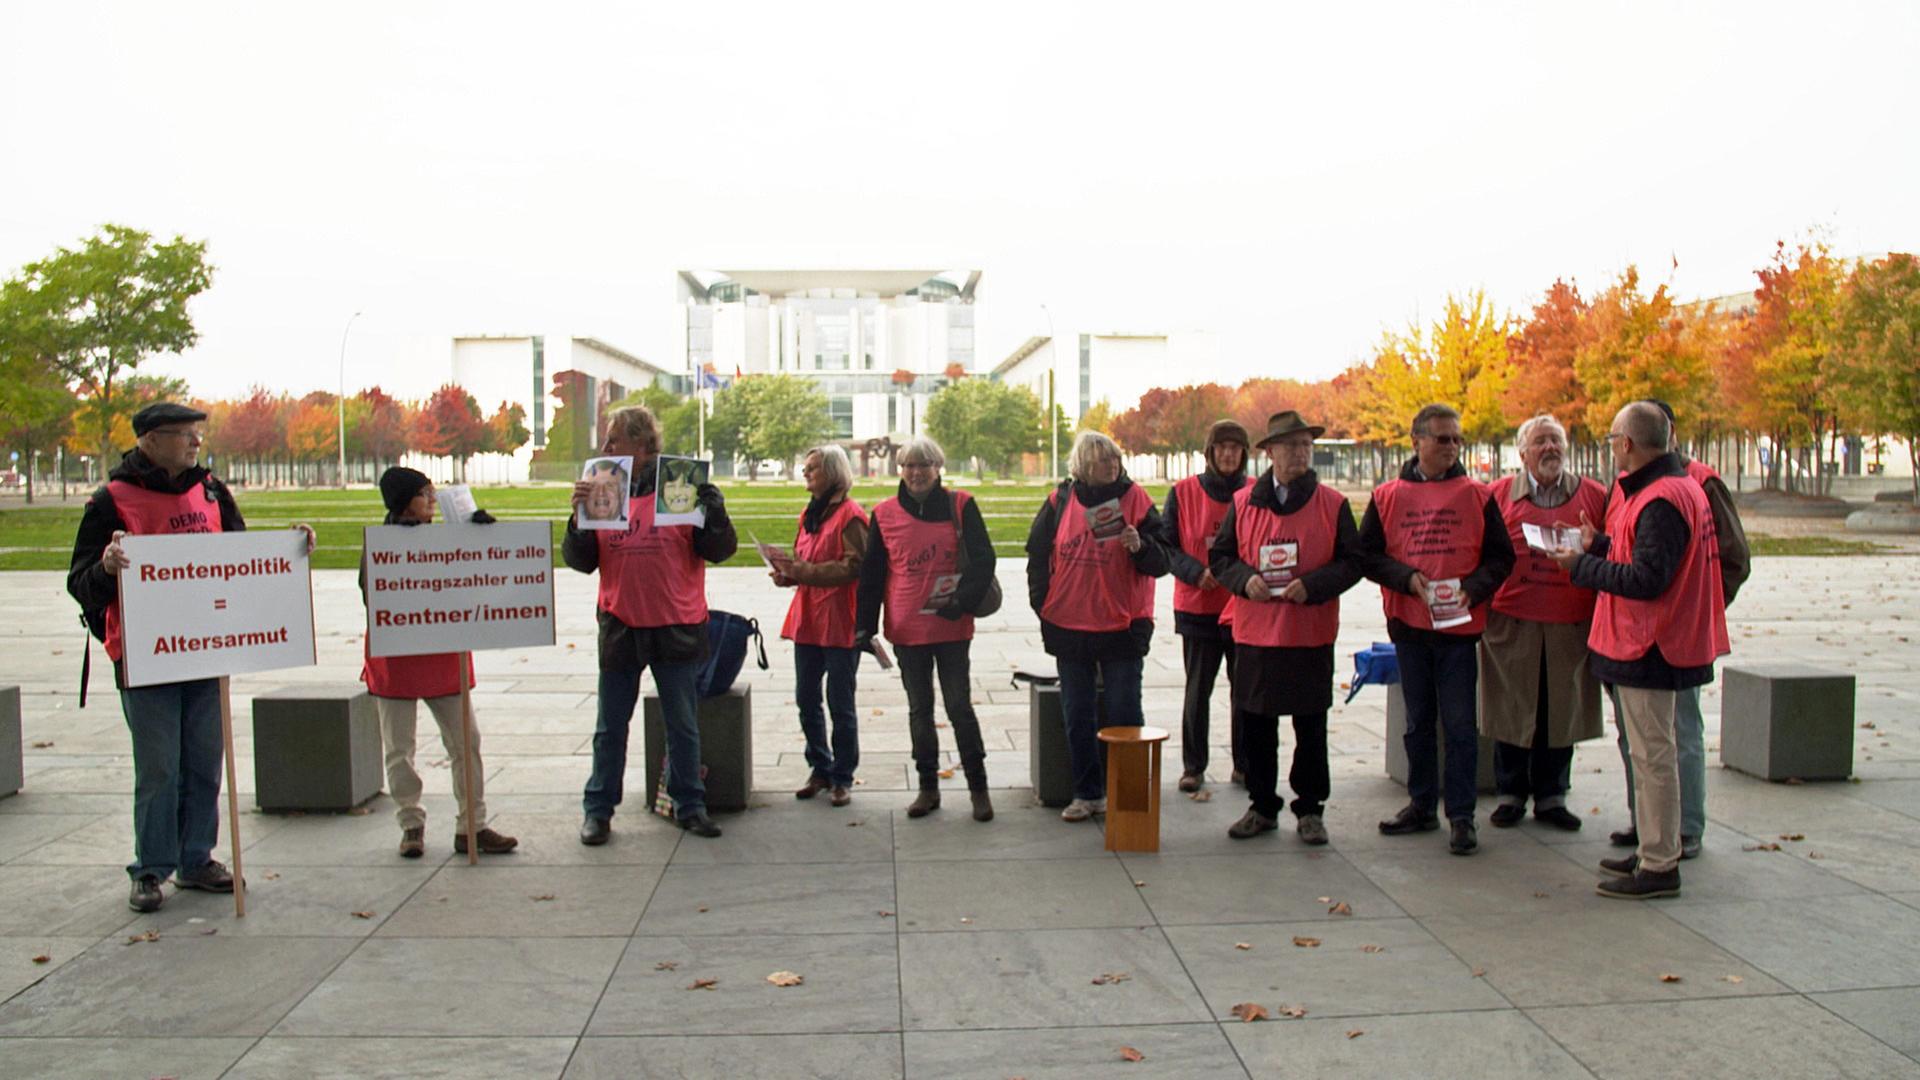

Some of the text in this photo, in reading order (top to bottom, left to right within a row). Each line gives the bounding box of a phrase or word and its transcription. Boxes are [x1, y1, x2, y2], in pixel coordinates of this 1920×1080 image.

[169, 511, 208, 530] DEMO
[372, 546, 546, 565] Wir kämpfen für alle
[140, 556, 292, 582] Rentenpolitik
[375, 572, 545, 592] Beitragszahler und
[375, 604, 548, 627] Rentner/innen
[153, 626, 289, 655] Altersarmut
